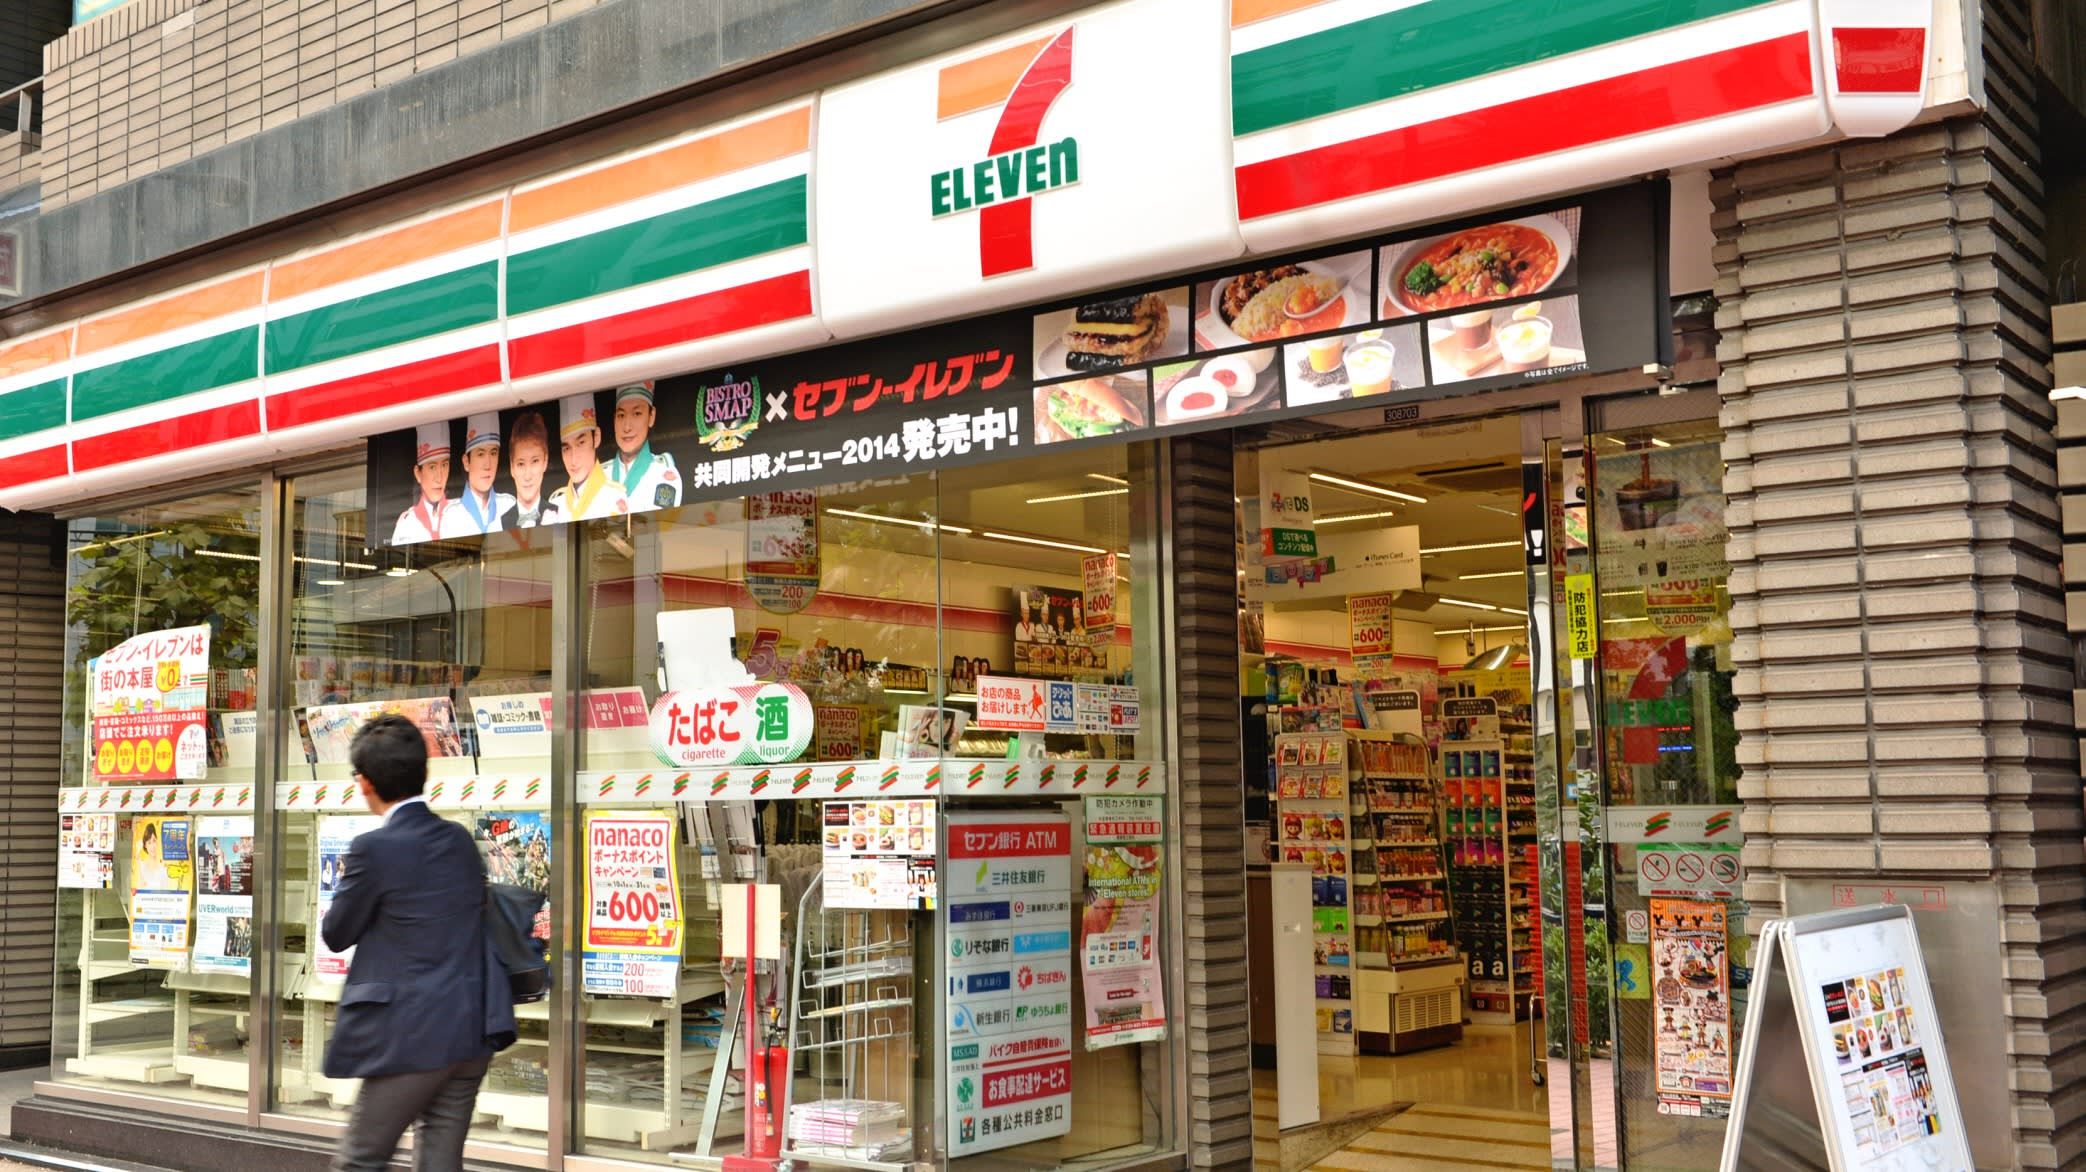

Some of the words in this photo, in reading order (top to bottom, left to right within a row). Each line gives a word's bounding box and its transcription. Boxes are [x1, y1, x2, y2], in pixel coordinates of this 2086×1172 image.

[706, 381, 751, 404] BISTRO
[705, 398, 752, 424] SMAP
[1386, 407, 1417, 422] 308703
[1092, 593, 1110, 612] 600
[1352, 597, 1389, 609] nanaco
[1573, 591, 1589, 653] 防犯協力店
[1359, 627, 1384, 643] 600
[981, 686, 1022, 701] お店の商品
[668, 698, 741, 746] たばこ
[755, 695, 789, 742] 酒
[819, 709, 857, 721] nanaco
[681, 748, 726, 761] cigarette
[759, 745, 790, 758] liquor
[829, 742, 851, 757] 600
[594, 827, 664, 847] nanaco
[963, 832, 1021, 851] セブン銀行
[1026, 831, 1057, 849] ATM
[594, 850, 664, 865] ボーナスポイント
[594, 866, 639, 878] キャンペーン
[992, 869, 1046, 886] 三井住友銀行
[198, 904, 234, 914] UVERworld
[608, 890, 659, 922] 600
[965, 938, 1009, 955] りそな銀行
[624, 963, 645, 977] 200
[625, 979, 644, 994] 100
[976, 1009, 1010, 1026] 新生銀行
[1030, 1002, 1068, 1018] ゆうちょ銀行
[988, 1068, 1067, 1101] お食事配達サービス
[981, 1105, 1063, 1137] 各種公共料金窓口
